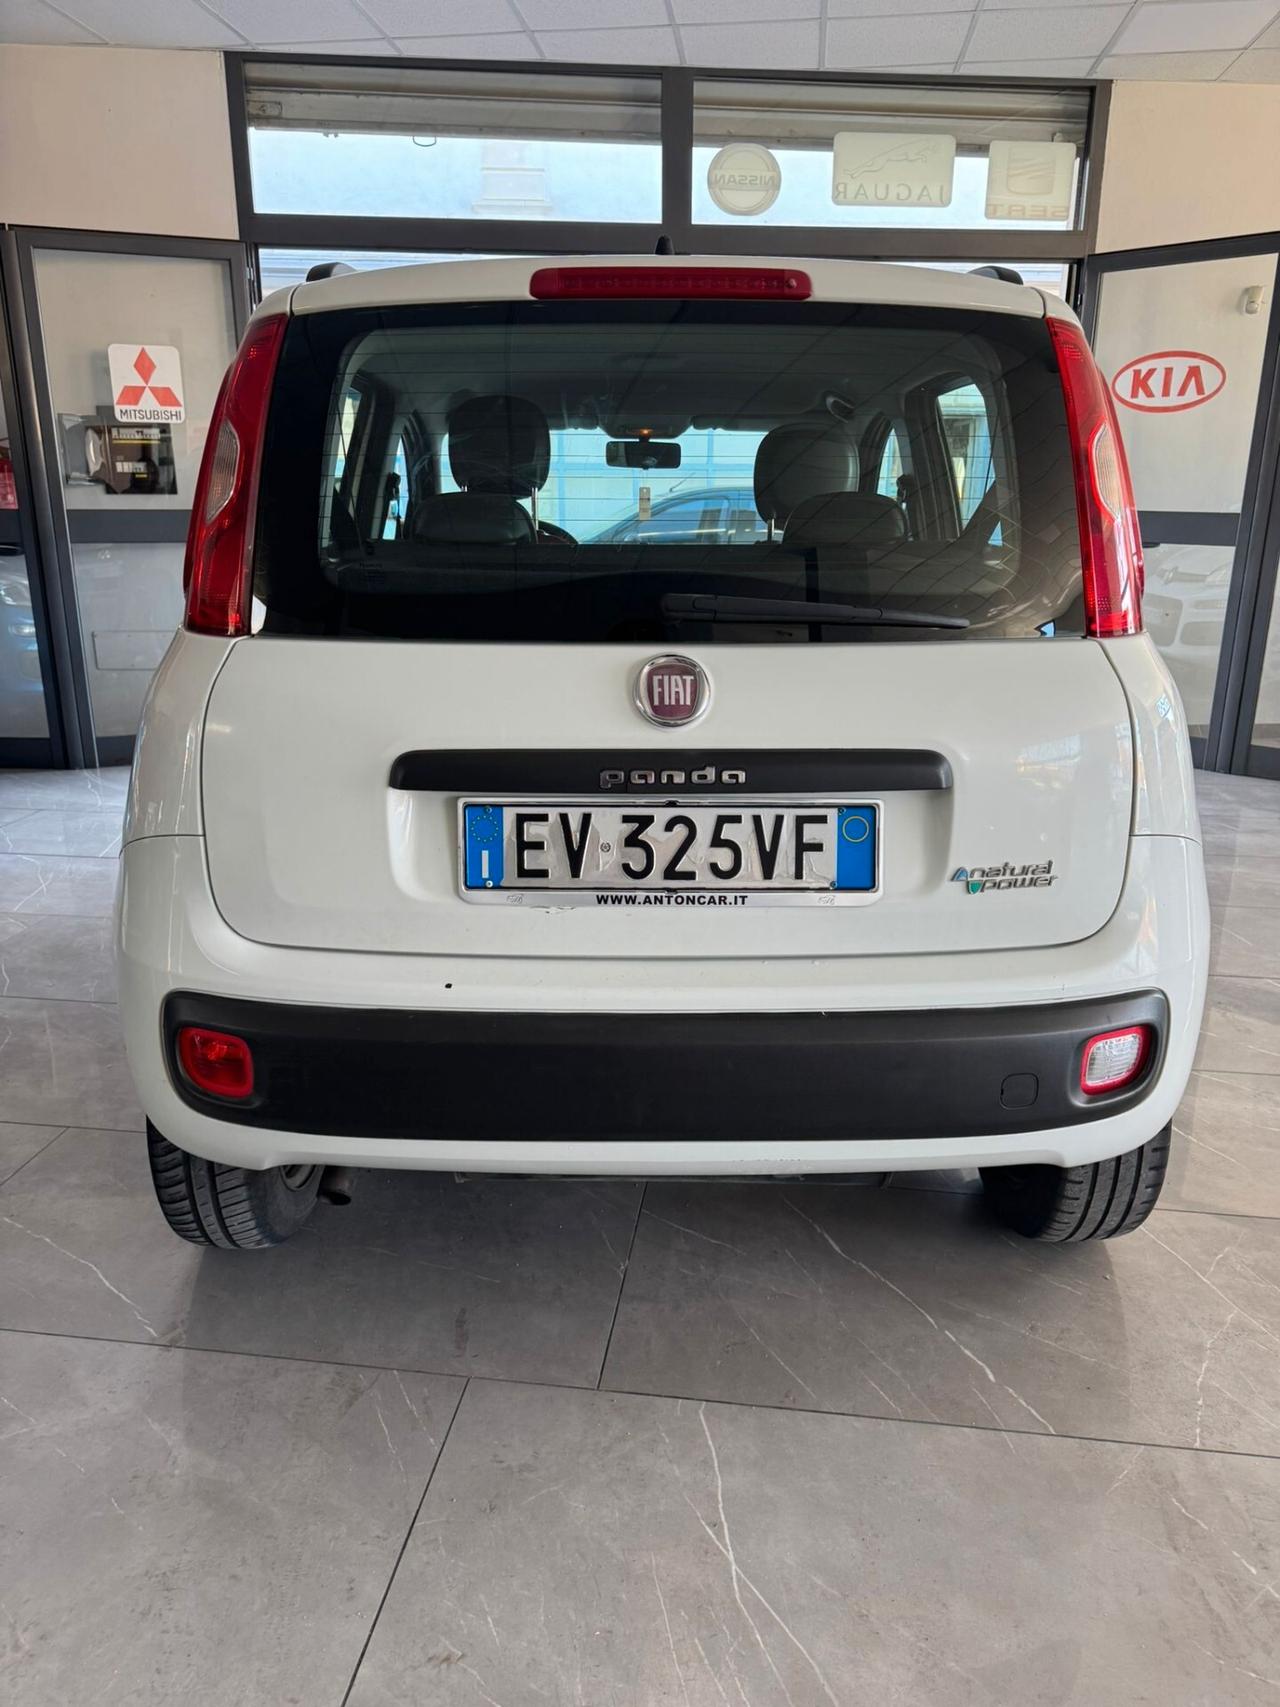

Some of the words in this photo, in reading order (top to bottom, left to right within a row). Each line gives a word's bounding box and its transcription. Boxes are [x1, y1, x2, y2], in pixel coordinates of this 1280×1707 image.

[1130, 365, 1205, 399] KIA
[119, 408, 182, 422] MITSUBISHI
[652, 674, 695, 706] FIAT
[599, 765, 746, 789] panda
[969, 859, 1054, 879] natural
[979, 875, 1059, 893] power
[596, 894, 748, 906] WWW.ANTONCAR.IT
